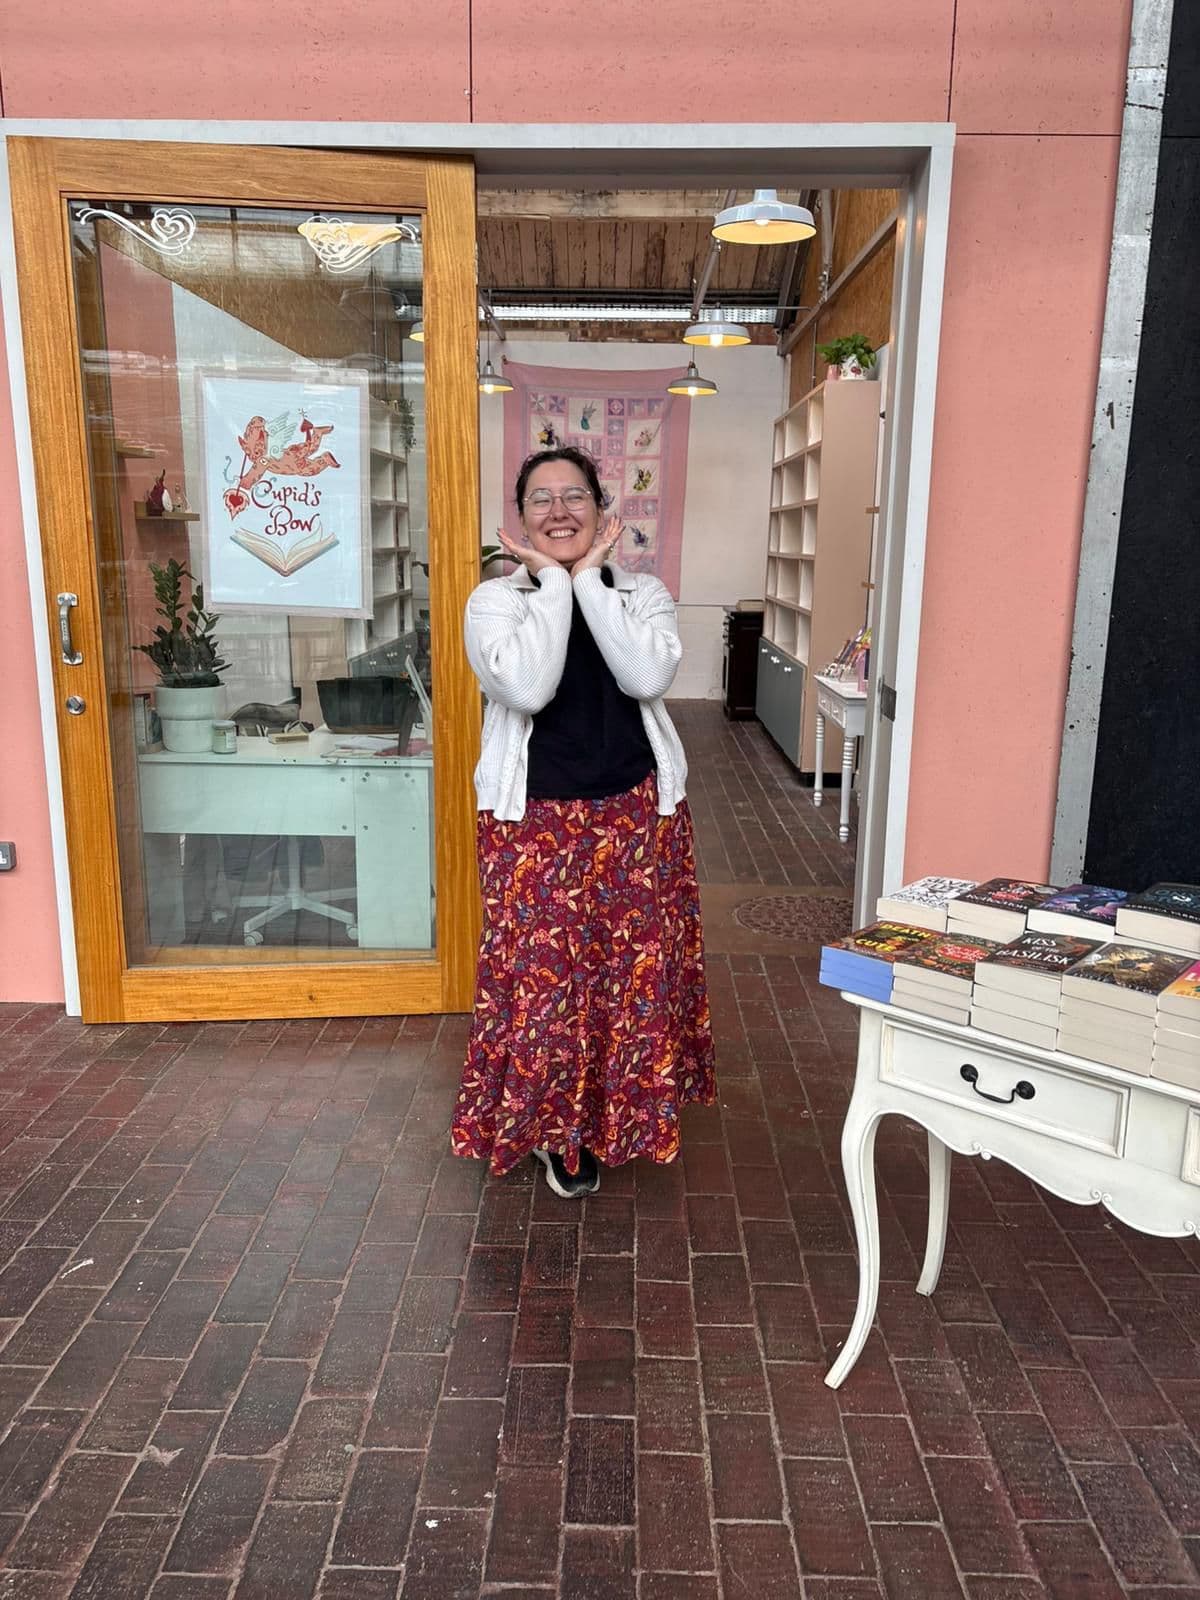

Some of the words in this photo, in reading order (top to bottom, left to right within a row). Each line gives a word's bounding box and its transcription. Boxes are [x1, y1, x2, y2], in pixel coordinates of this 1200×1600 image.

[251, 480, 322, 509] Cupid's
[265, 505, 320, 536] Bow
[880, 923, 931, 938] DEATH
[856, 938, 897, 953] CUTE
[1022, 937, 1056, 947] KISS
[995, 949, 1068, 965] BASILISK
